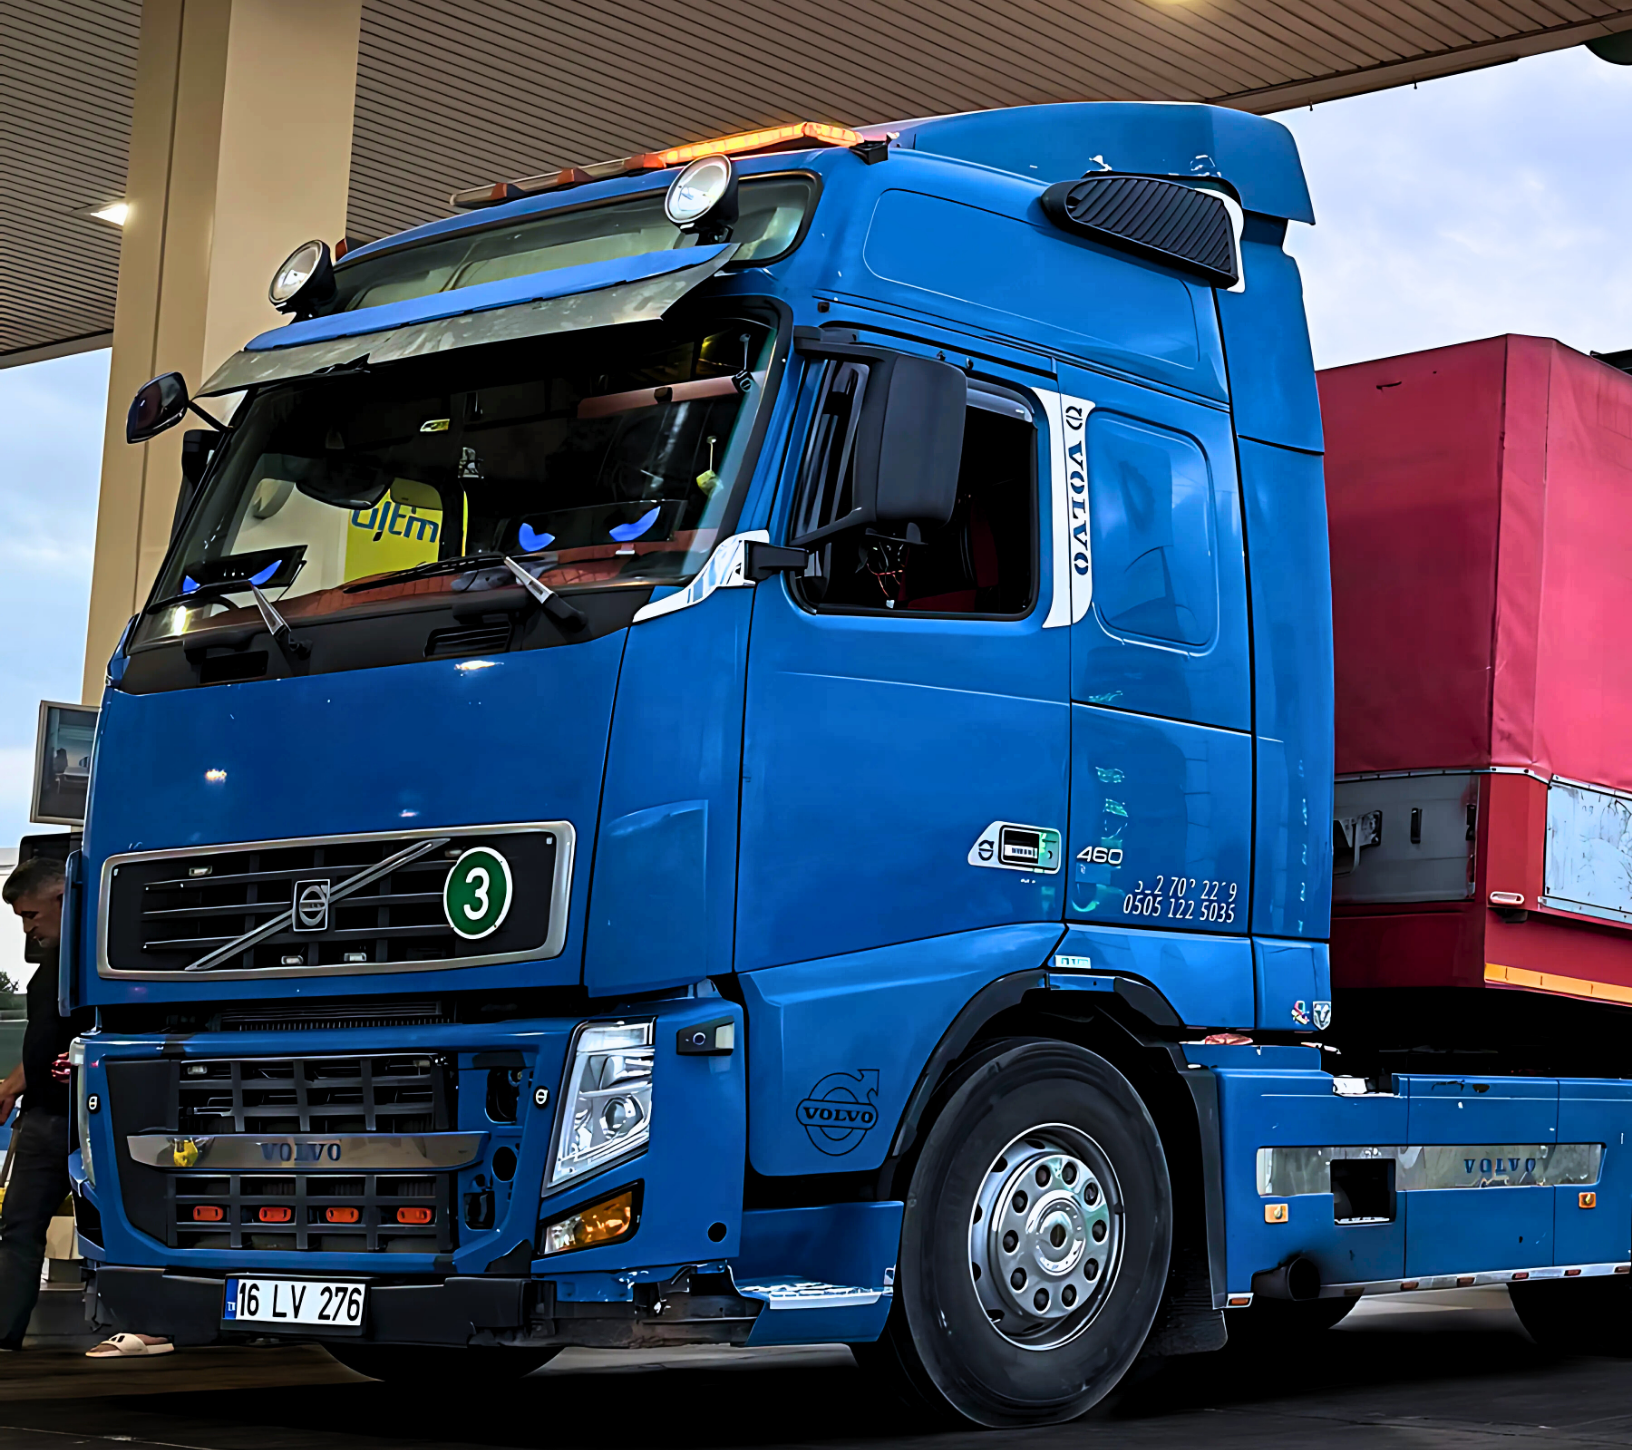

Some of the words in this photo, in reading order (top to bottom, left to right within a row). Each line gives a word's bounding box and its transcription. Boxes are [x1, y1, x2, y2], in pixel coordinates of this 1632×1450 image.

[1068, 440, 1089, 576] VOLVO
[1076, 846, 1124, 865] 460
[463, 866, 490, 921] 3
[1123, 894, 1163, 917] 0505
[1168, 898, 1195, 919] 122
[1199, 901, 1235, 923] 5035
[803, 1107, 874, 1124] VOLVO
[1463, 1157, 1537, 1175] VOLVO
[239, 1282, 260, 1317] 16
[272, 1284, 307, 1319] LV
[317, 1286, 362, 1322] 276
